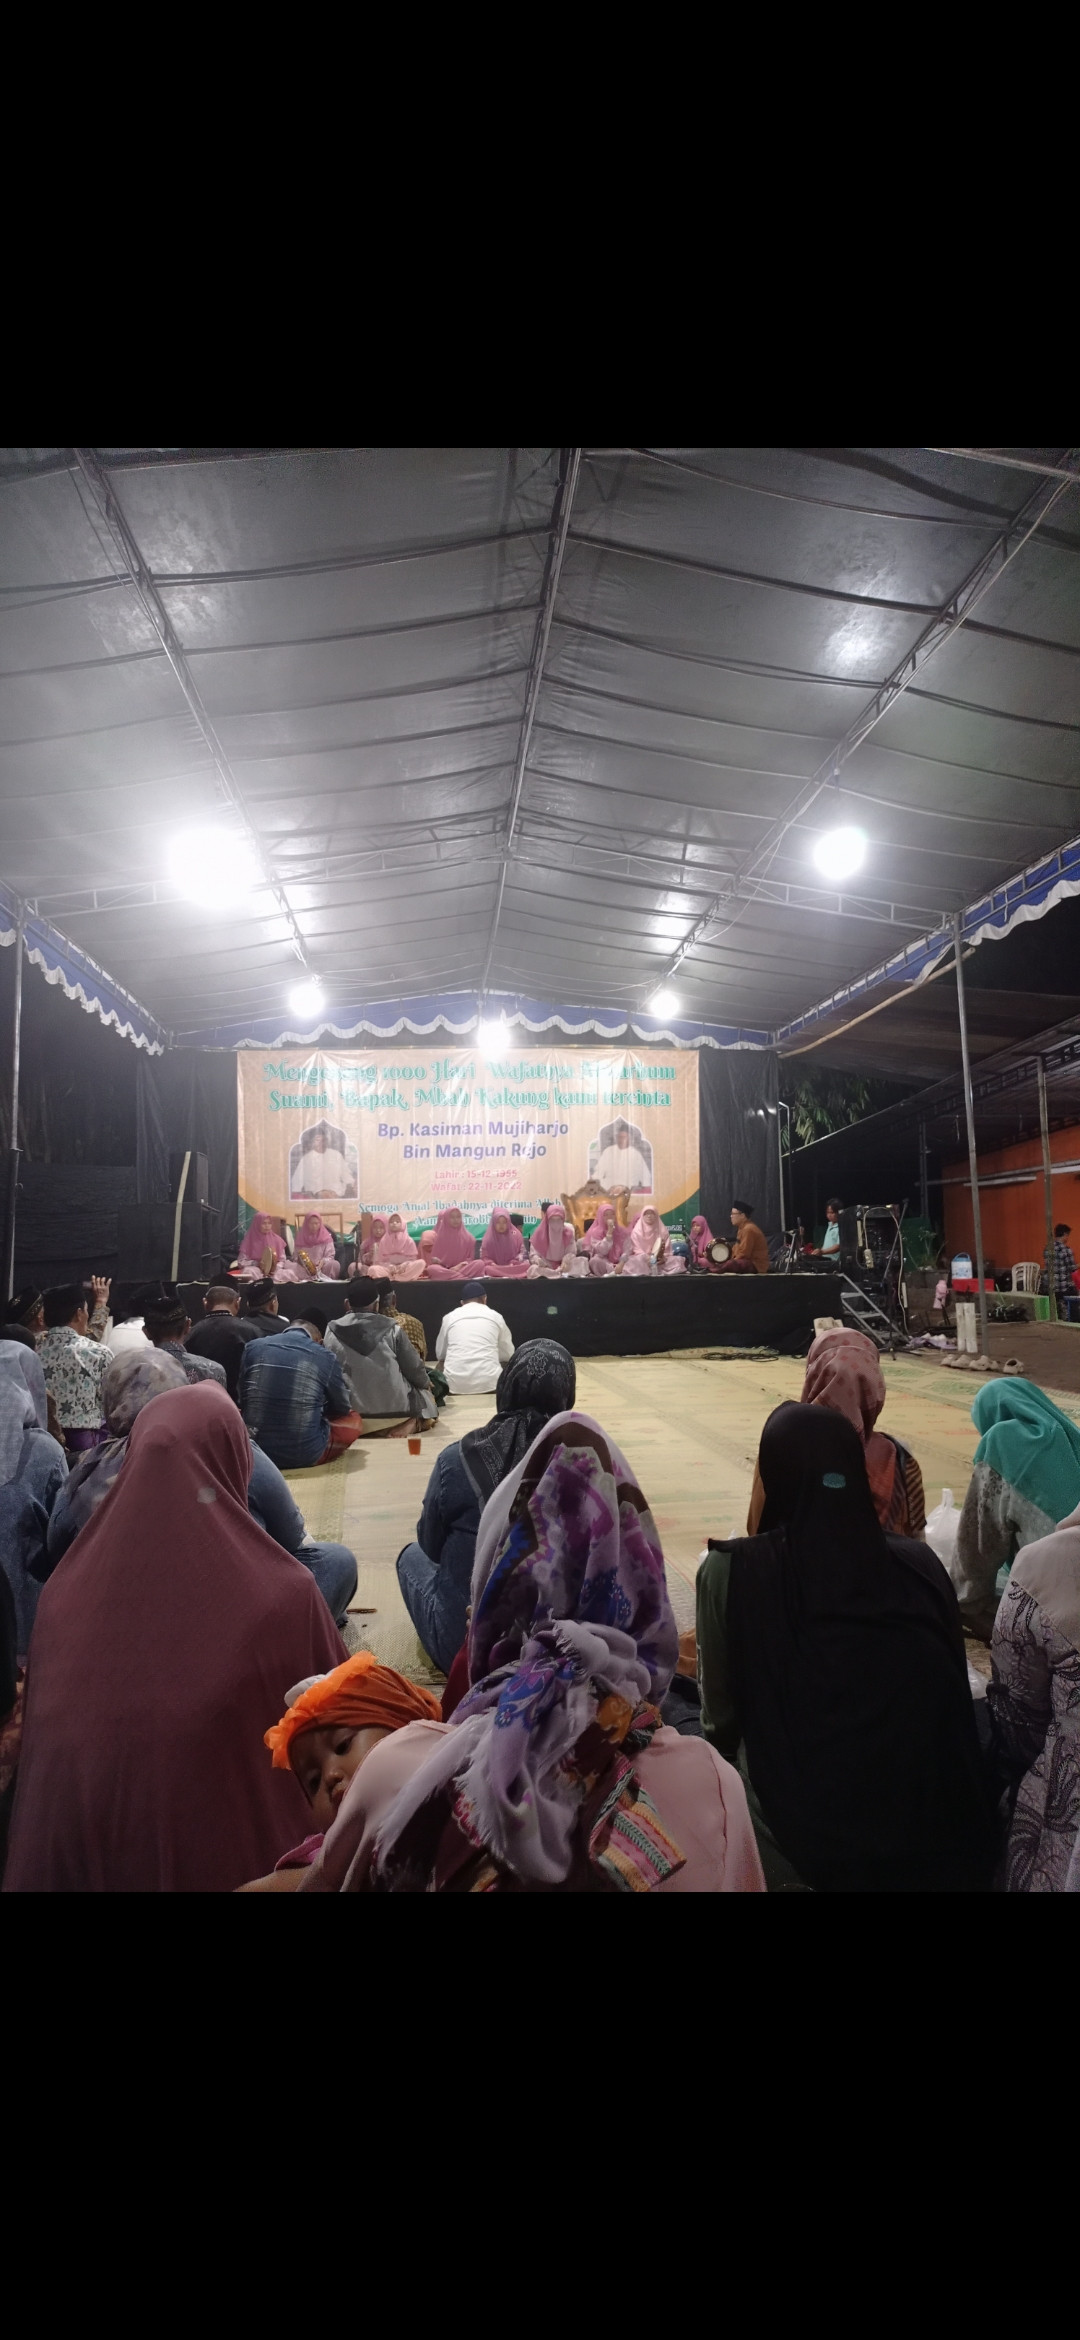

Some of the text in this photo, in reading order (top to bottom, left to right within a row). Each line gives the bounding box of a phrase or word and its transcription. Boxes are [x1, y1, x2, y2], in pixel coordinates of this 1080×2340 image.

[263, 1060, 377, 1085] Mengeng
[431, 1058, 475, 1082] Hari
[485, 1060, 574, 1083] Wafatnya
[580, 1060, 676, 1080] Alarhum
[269, 1090, 334, 1111] Suami,
[414, 1085, 471, 1107] Mbah
[475, 1087, 550, 1109] Kakung
[554, 1086, 597, 1108] kami
[602, 1088, 671, 1107] tercinta
[377, 1120, 569, 1139] Bp. Kasiman Mujiharjo
[403, 1143, 547, 1160] Bin Mangun Rejo
[358, 1202, 399, 1214] Semoga
[402, 1201, 430, 1211] Amal
